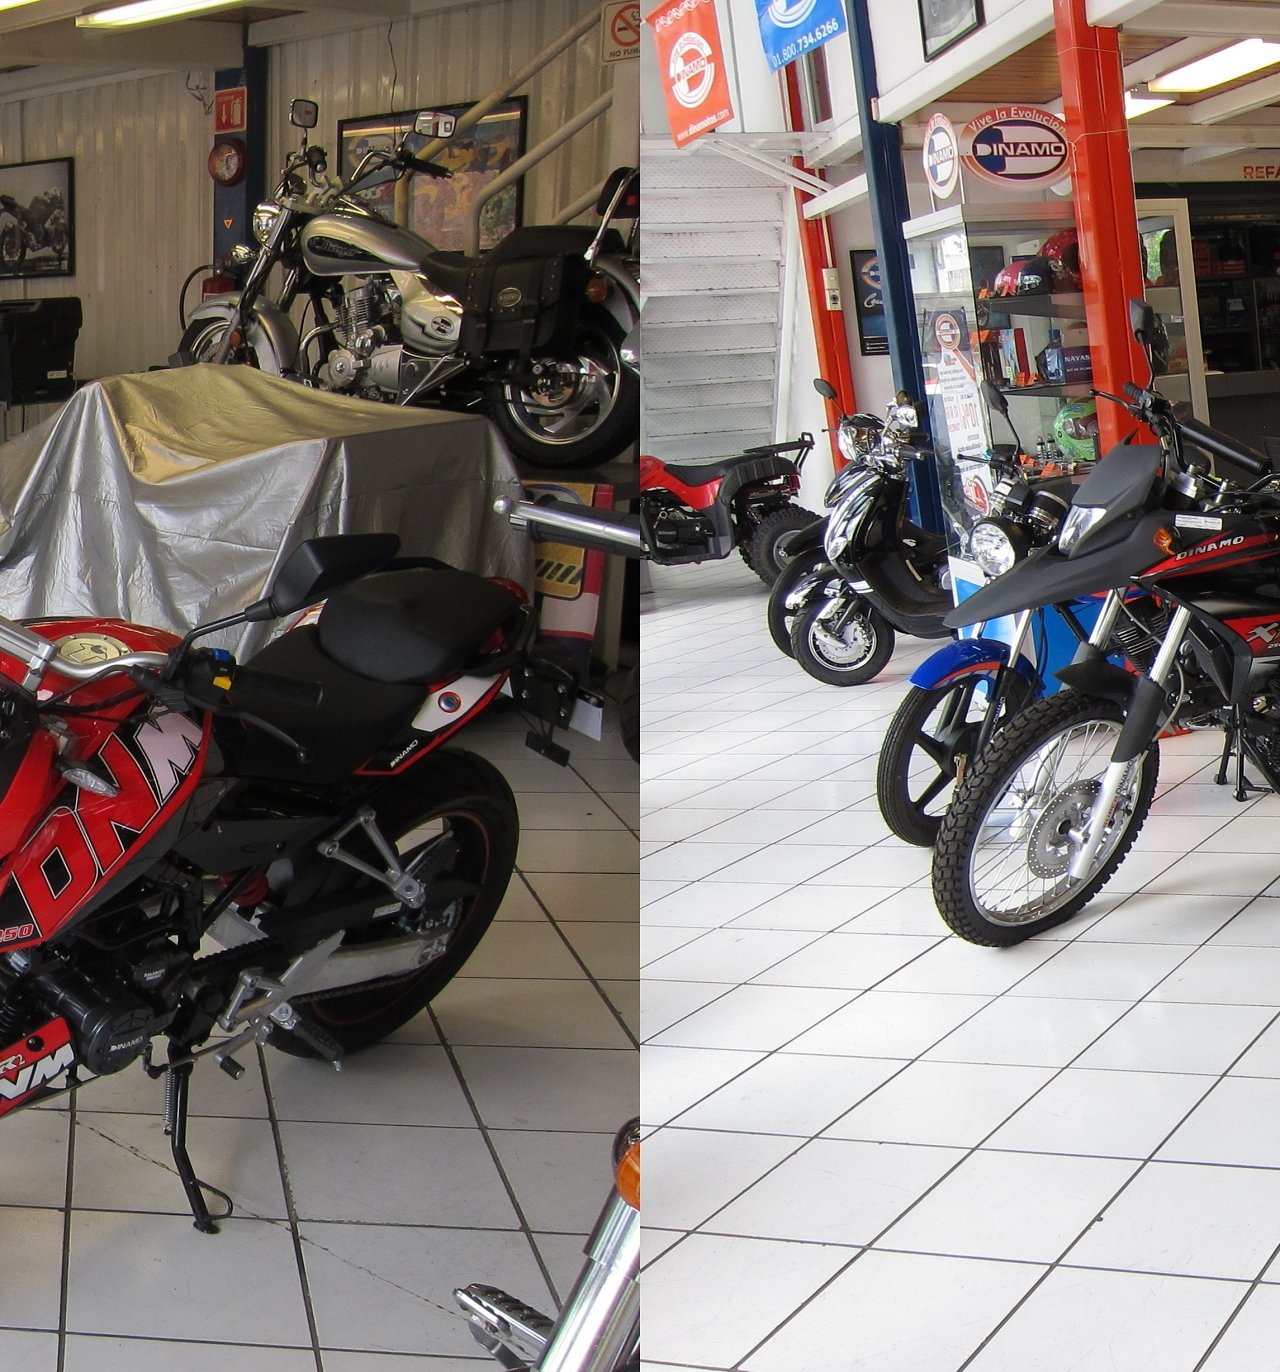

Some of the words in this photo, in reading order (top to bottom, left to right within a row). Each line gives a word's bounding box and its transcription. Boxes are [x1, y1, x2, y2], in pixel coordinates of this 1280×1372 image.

[772, 18, 839, 68] 01.800.734.6266
[968, 115, 992, 132] Vive
[995, 110, 1007, 119] la
[1011, 106, 1066, 133] Evolución
[975, 142, 1066, 157] DINAMO
[1175, 535, 1245, 561] DINAMO
[389, 739, 419, 768] DINAMO
[10, 705, 203, 940] DNM
[110, 1036, 144, 1051] DINAMO
